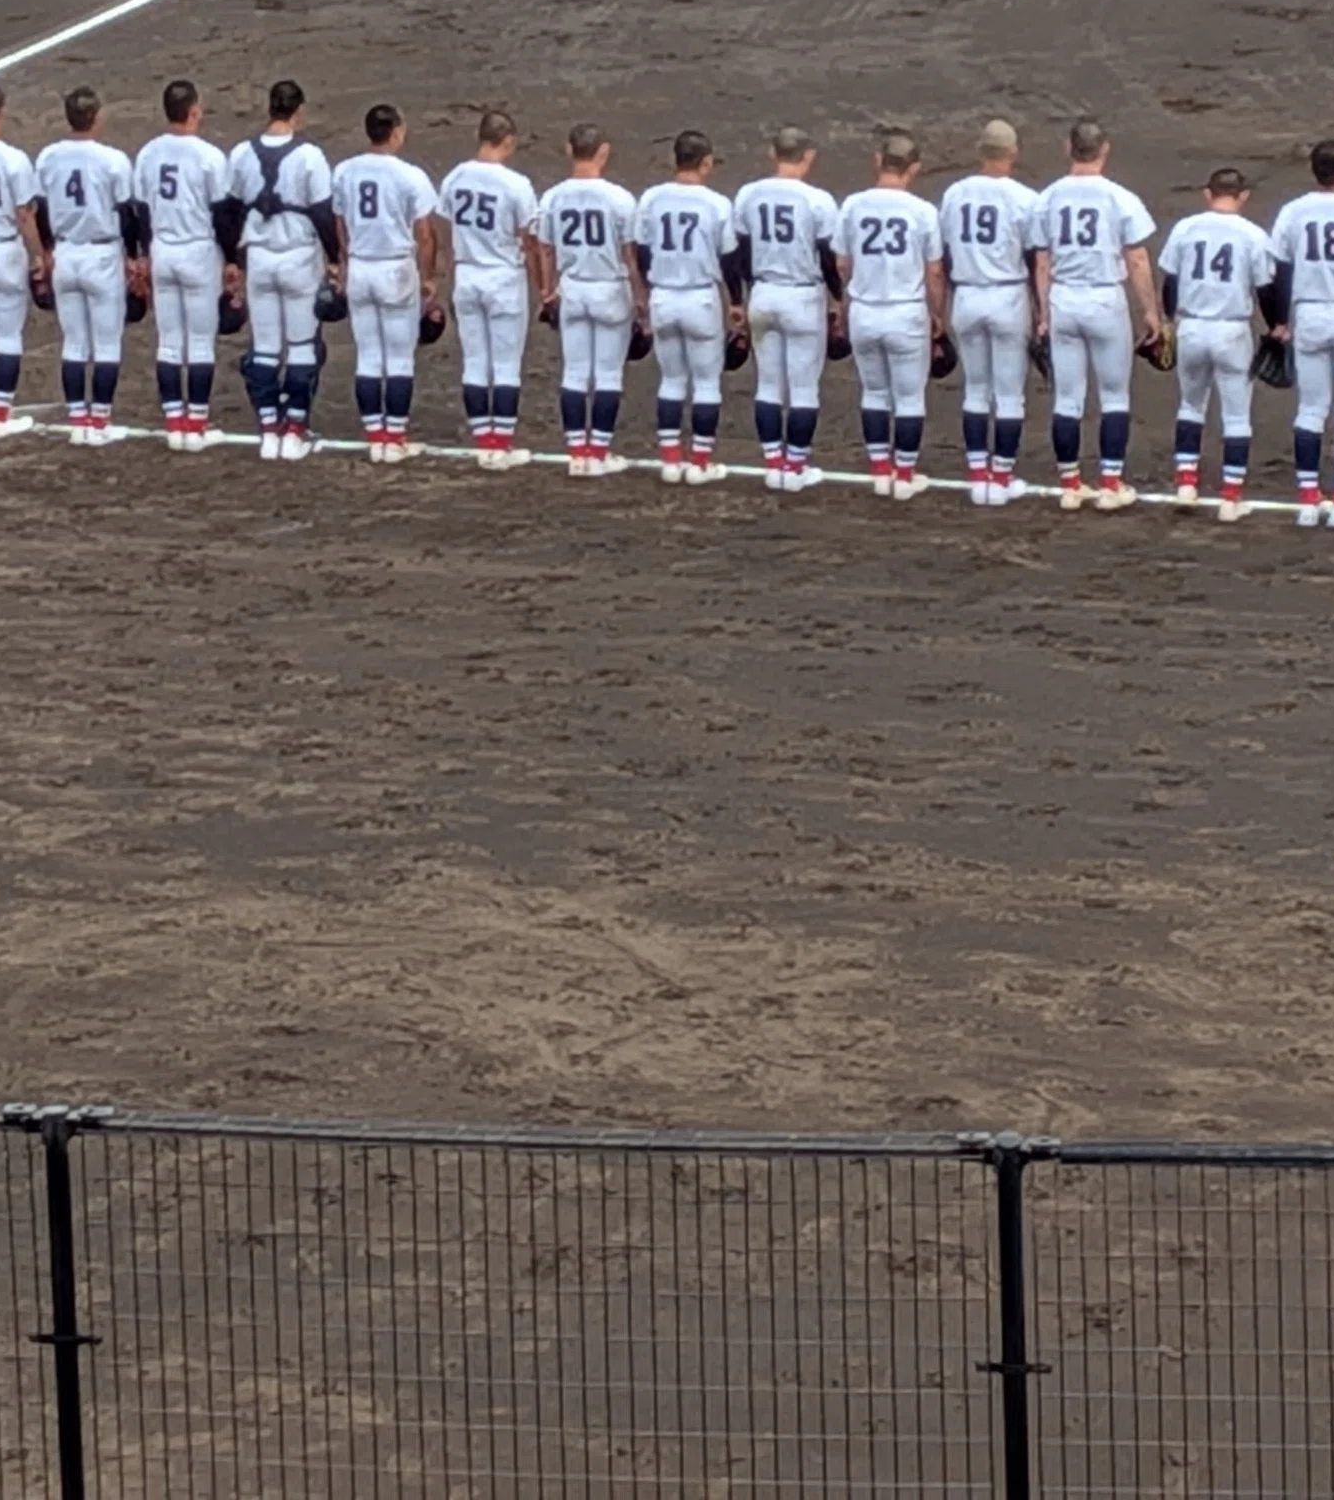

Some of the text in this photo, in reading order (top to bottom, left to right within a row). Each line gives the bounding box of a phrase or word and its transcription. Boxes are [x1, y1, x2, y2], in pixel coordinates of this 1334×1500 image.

[65, 170, 86, 207] 4
[158, 164, 178, 200] 5
[359, 181, 378, 219] 8
[454, 189, 497, 231] 25
[560, 209, 605, 247] 20
[759, 204, 794, 244] 15
[961, 204, 997, 244] 19
[1059, 206, 1098, 247] 13
[661, 213, 698, 252] 17
[860, 218, 907, 255] 23
[1191, 242, 1233, 282] 14
